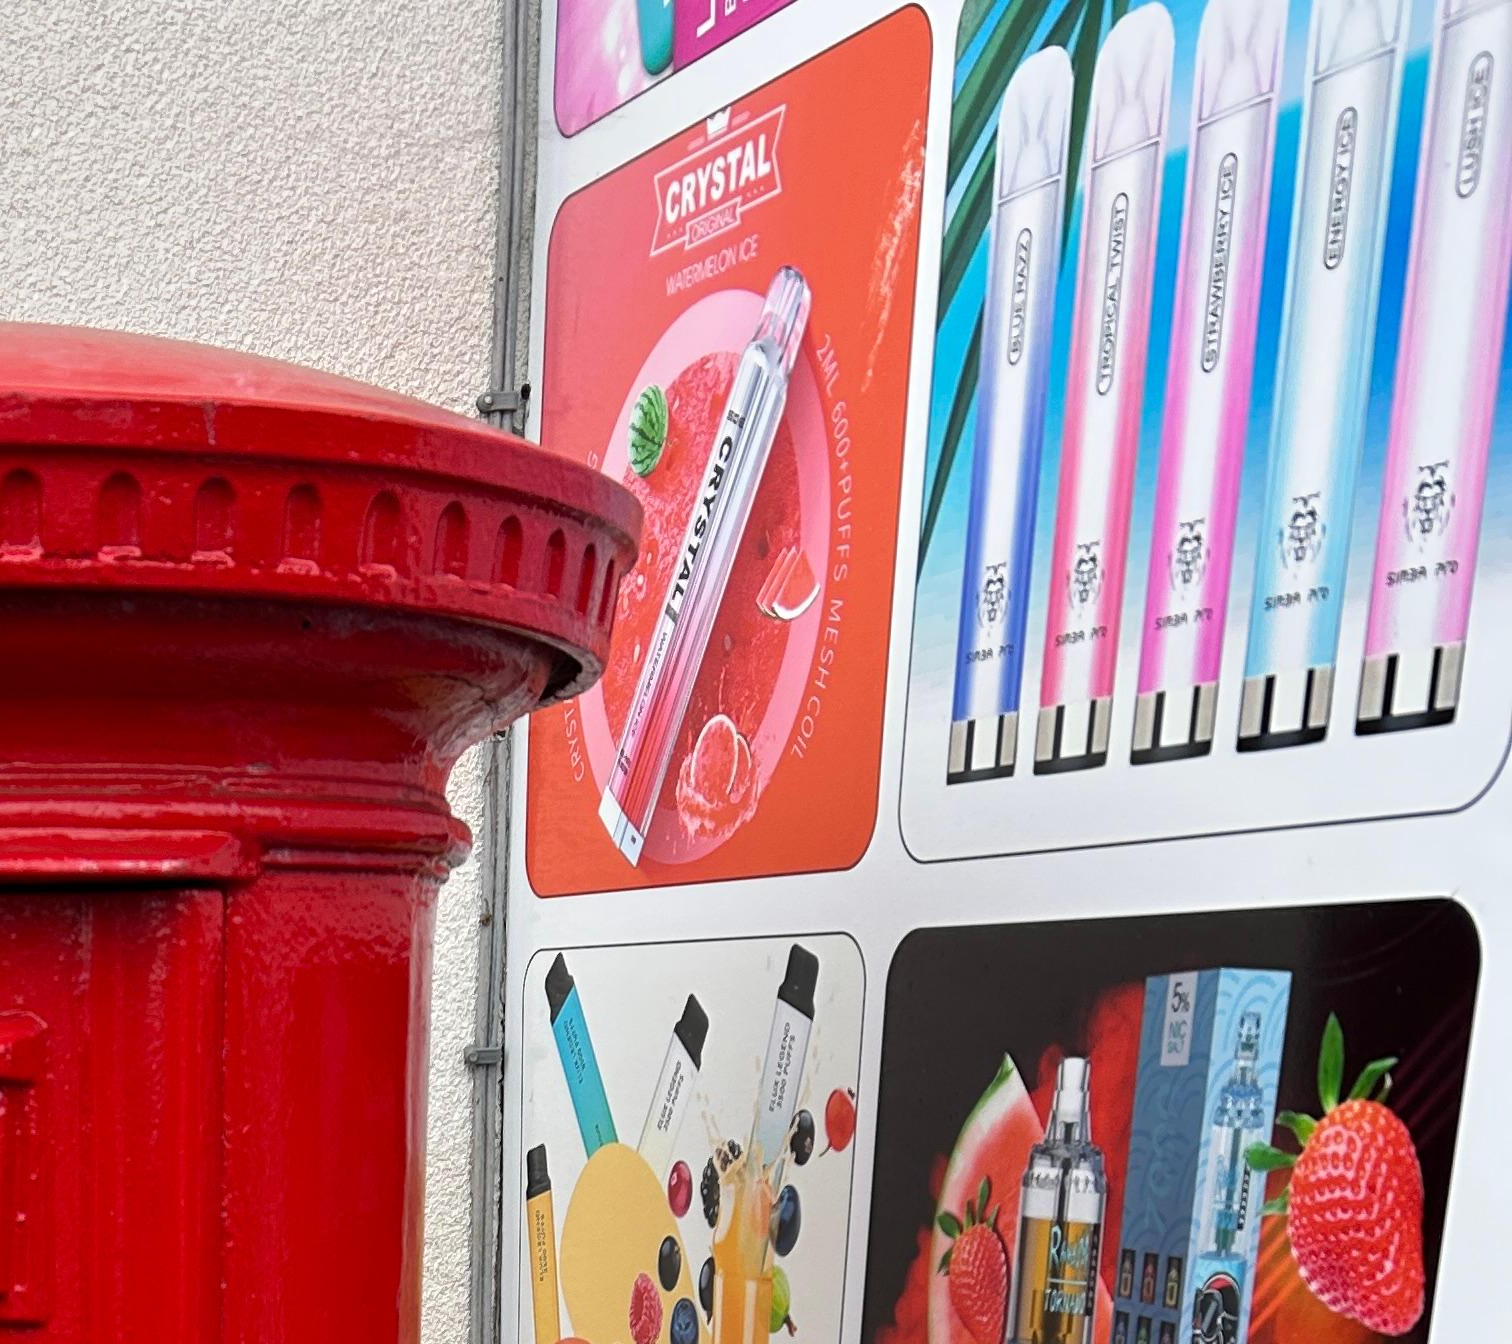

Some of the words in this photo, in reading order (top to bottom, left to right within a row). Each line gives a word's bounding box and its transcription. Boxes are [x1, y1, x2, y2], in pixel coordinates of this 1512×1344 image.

[665, 133, 771, 224] CRYSTAL
[691, 207, 734, 242] ORIGINAL
[666, 243, 737, 296] WATERMELON
[738, 233, 759, 265] ICE
[816, 333, 840, 398] 2ML
[672, 436, 733, 601] CRYSTAL
[815, 598, 844, 689] MESH
[790, 694, 821, 760] COIL
[1171, 982, 1190, 1012] 5%
